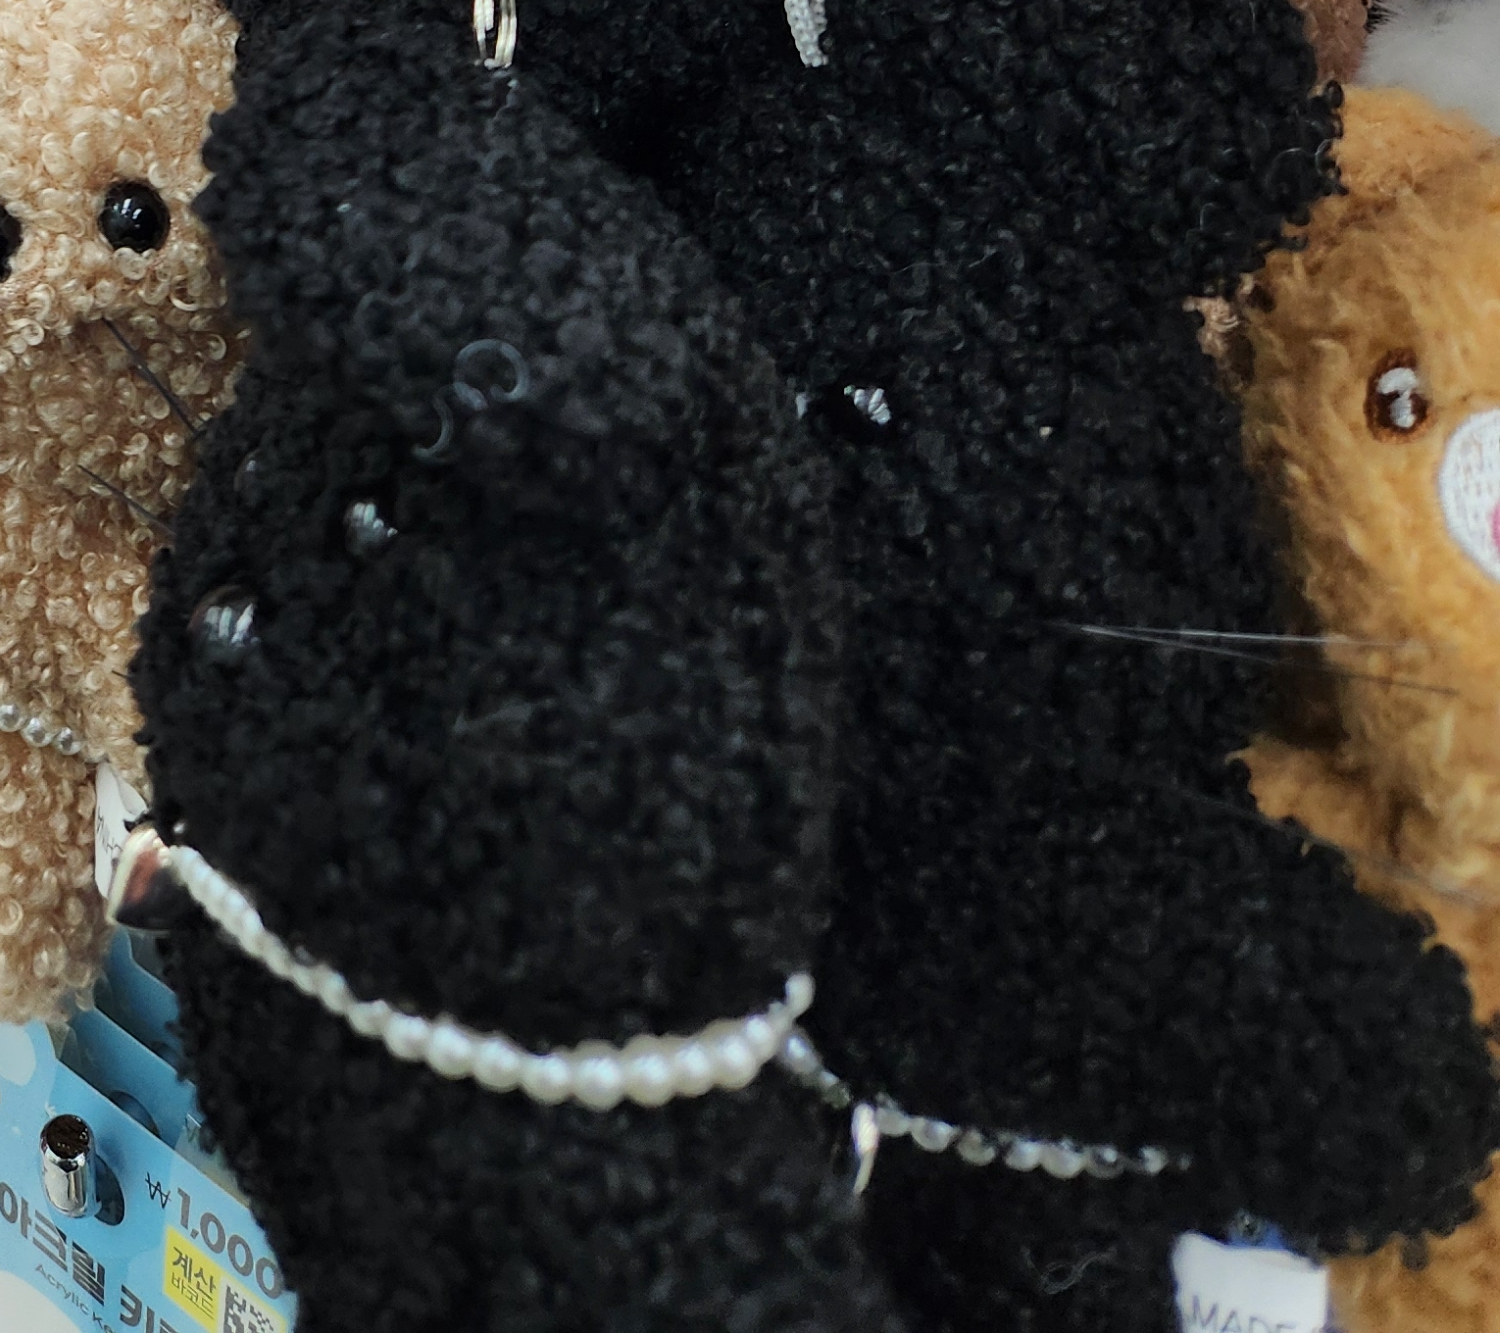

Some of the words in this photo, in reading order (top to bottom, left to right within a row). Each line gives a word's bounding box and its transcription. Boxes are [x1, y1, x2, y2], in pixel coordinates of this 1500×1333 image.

[35, 1263, 90, 1317] Acrylic
[172, 1246, 216, 1295] 계산
[119, 1284, 180, 1333] 키
[171, 1271, 214, 1321] 바코드
